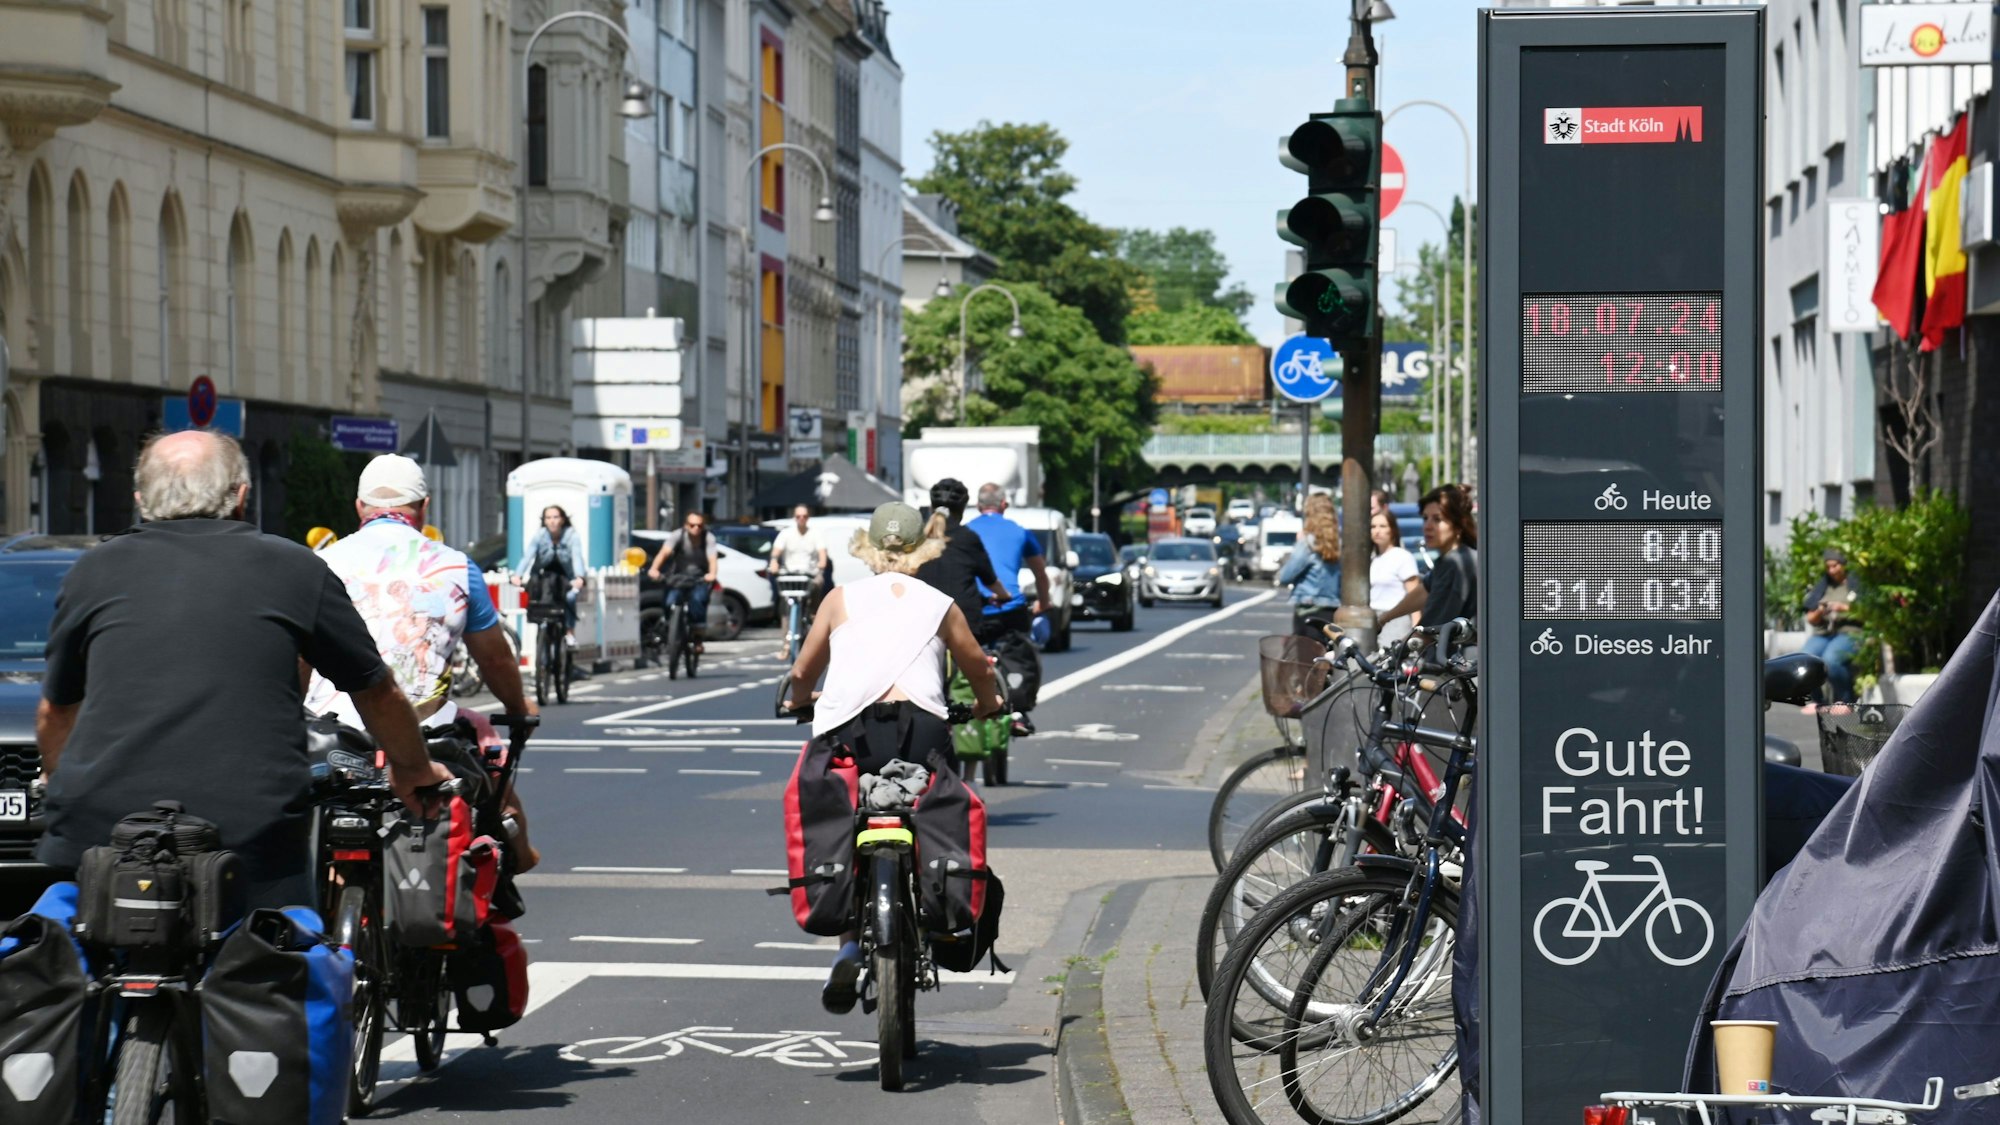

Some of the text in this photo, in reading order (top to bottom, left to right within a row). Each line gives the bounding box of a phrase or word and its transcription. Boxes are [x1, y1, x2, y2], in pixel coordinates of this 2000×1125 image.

[1584, 119, 1664, 133] Stadt Köln
[1844, 205, 1861, 324] CARMELO
[1526, 302, 1719, 336] 18.07.24
[1600, 352, 1719, 384] 12:00
[1643, 490, 1712, 510] Heute
[1643, 530, 1719, 562] 840
[1542, 579, 1719, 611] 314 034
[1575, 634, 1712, 655] Dieses Jahr
[1555, 727, 1692, 777] Gute
[1543, 786, 1704, 835] Fahrt!
